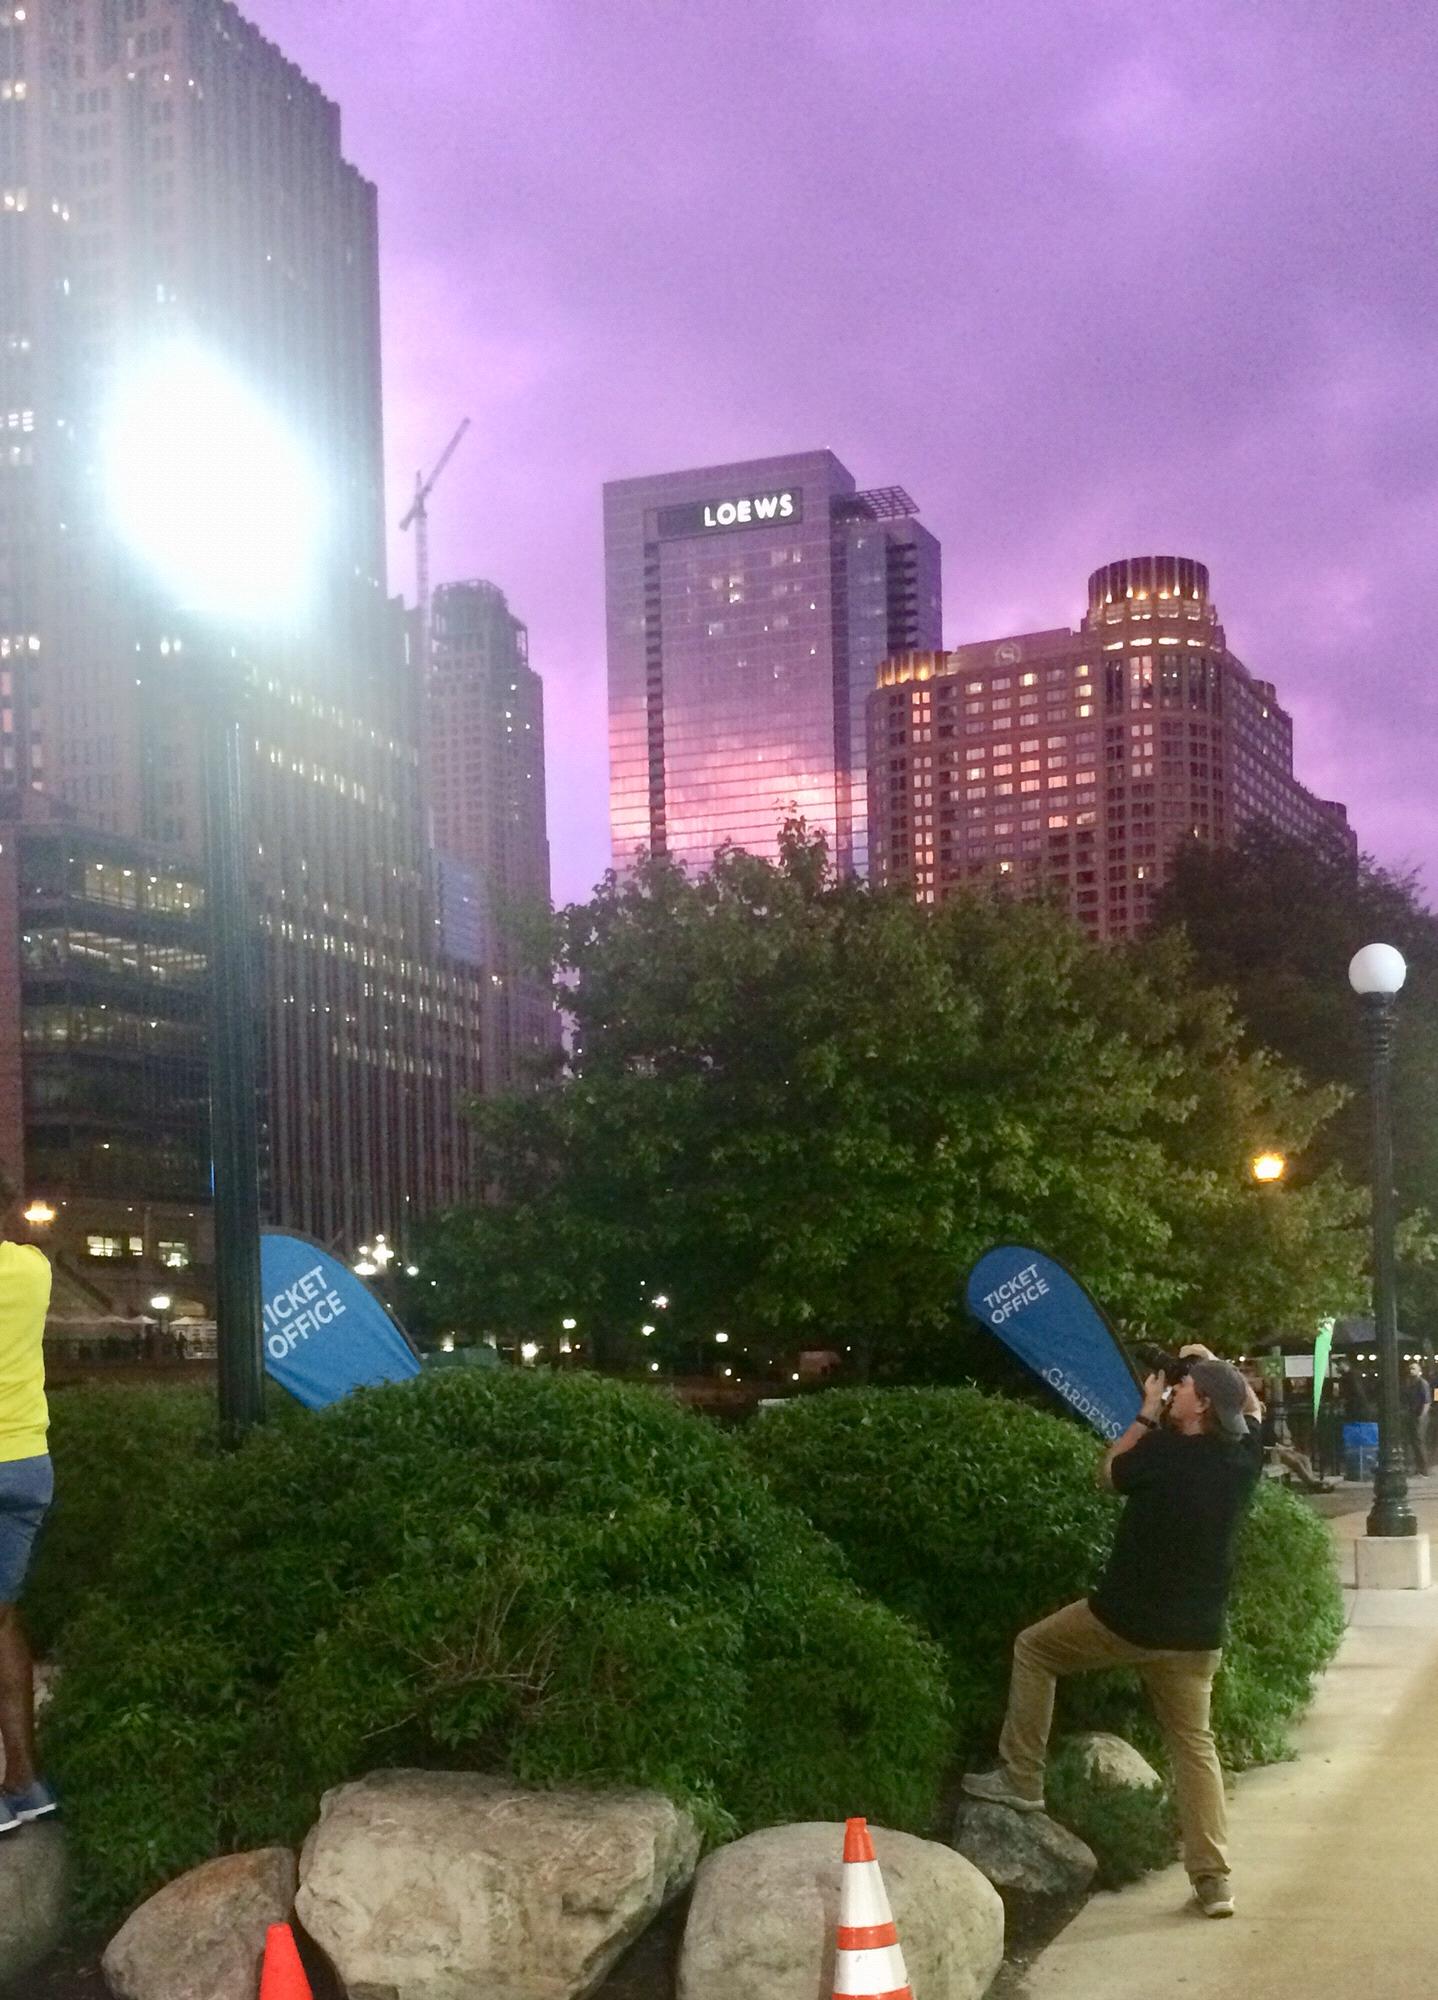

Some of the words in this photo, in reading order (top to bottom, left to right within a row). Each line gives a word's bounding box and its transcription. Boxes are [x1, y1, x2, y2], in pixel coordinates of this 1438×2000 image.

[704, 493, 793, 527] LOEWS
[983, 1263, 1038, 1309] TICKET
[991, 1278, 1050, 1324] OFFICE
[267, 1289, 347, 1359] OFFICE
